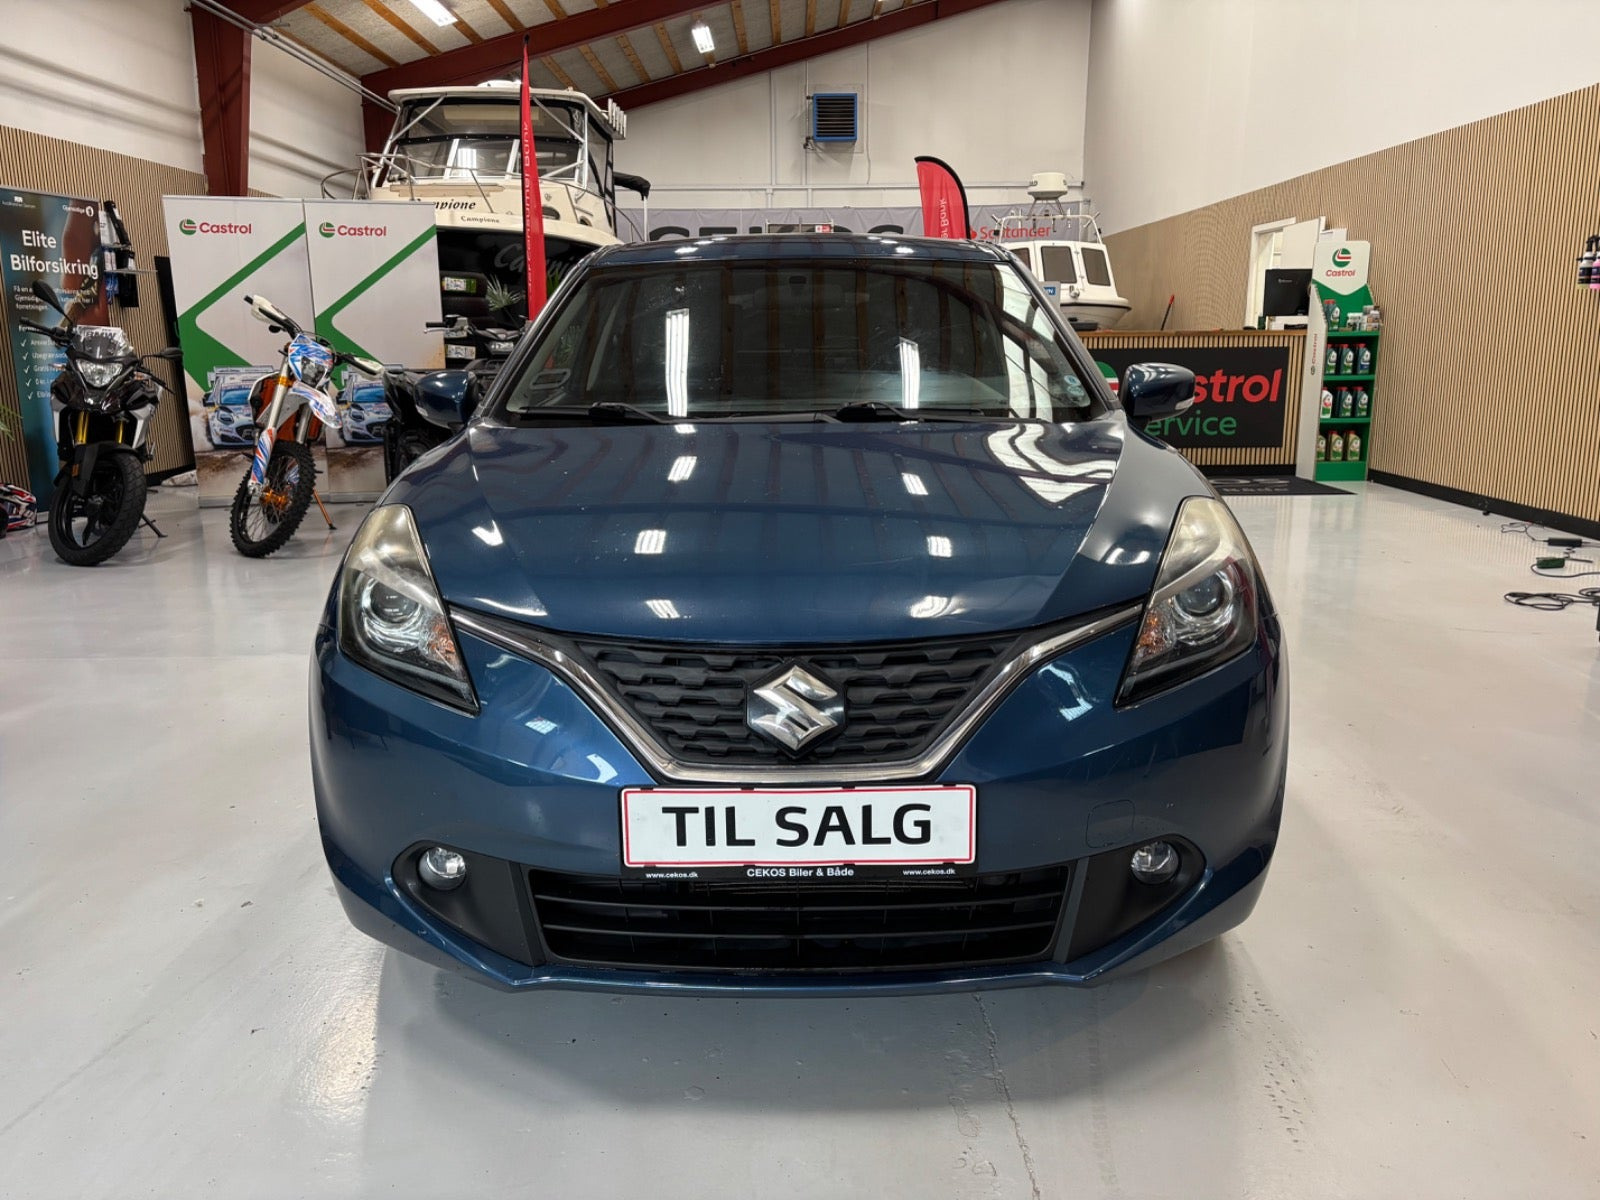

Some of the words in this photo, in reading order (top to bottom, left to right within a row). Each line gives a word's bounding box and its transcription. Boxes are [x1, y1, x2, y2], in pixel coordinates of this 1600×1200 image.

[199, 221, 252, 235] Castrol
[337, 224, 386, 237] Castrol
[22, 229, 57, 248] Elite
[10, 254, 98, 280] Bilforsikring
[1325, 269, 1356, 277] Castrol
[1194, 368, 1283, 403] strol
[1145, 410, 1237, 436] ervice
[662, 806, 755, 846] TIL
[775, 803, 931, 847] SALG
[746, 868, 786, 877] CEKOS
[789, 867, 814, 877] Biler
[816, 867, 824, 876] &
[826, 866, 854, 877] Både
[902, 868, 956, 876] www.cekos.dk
